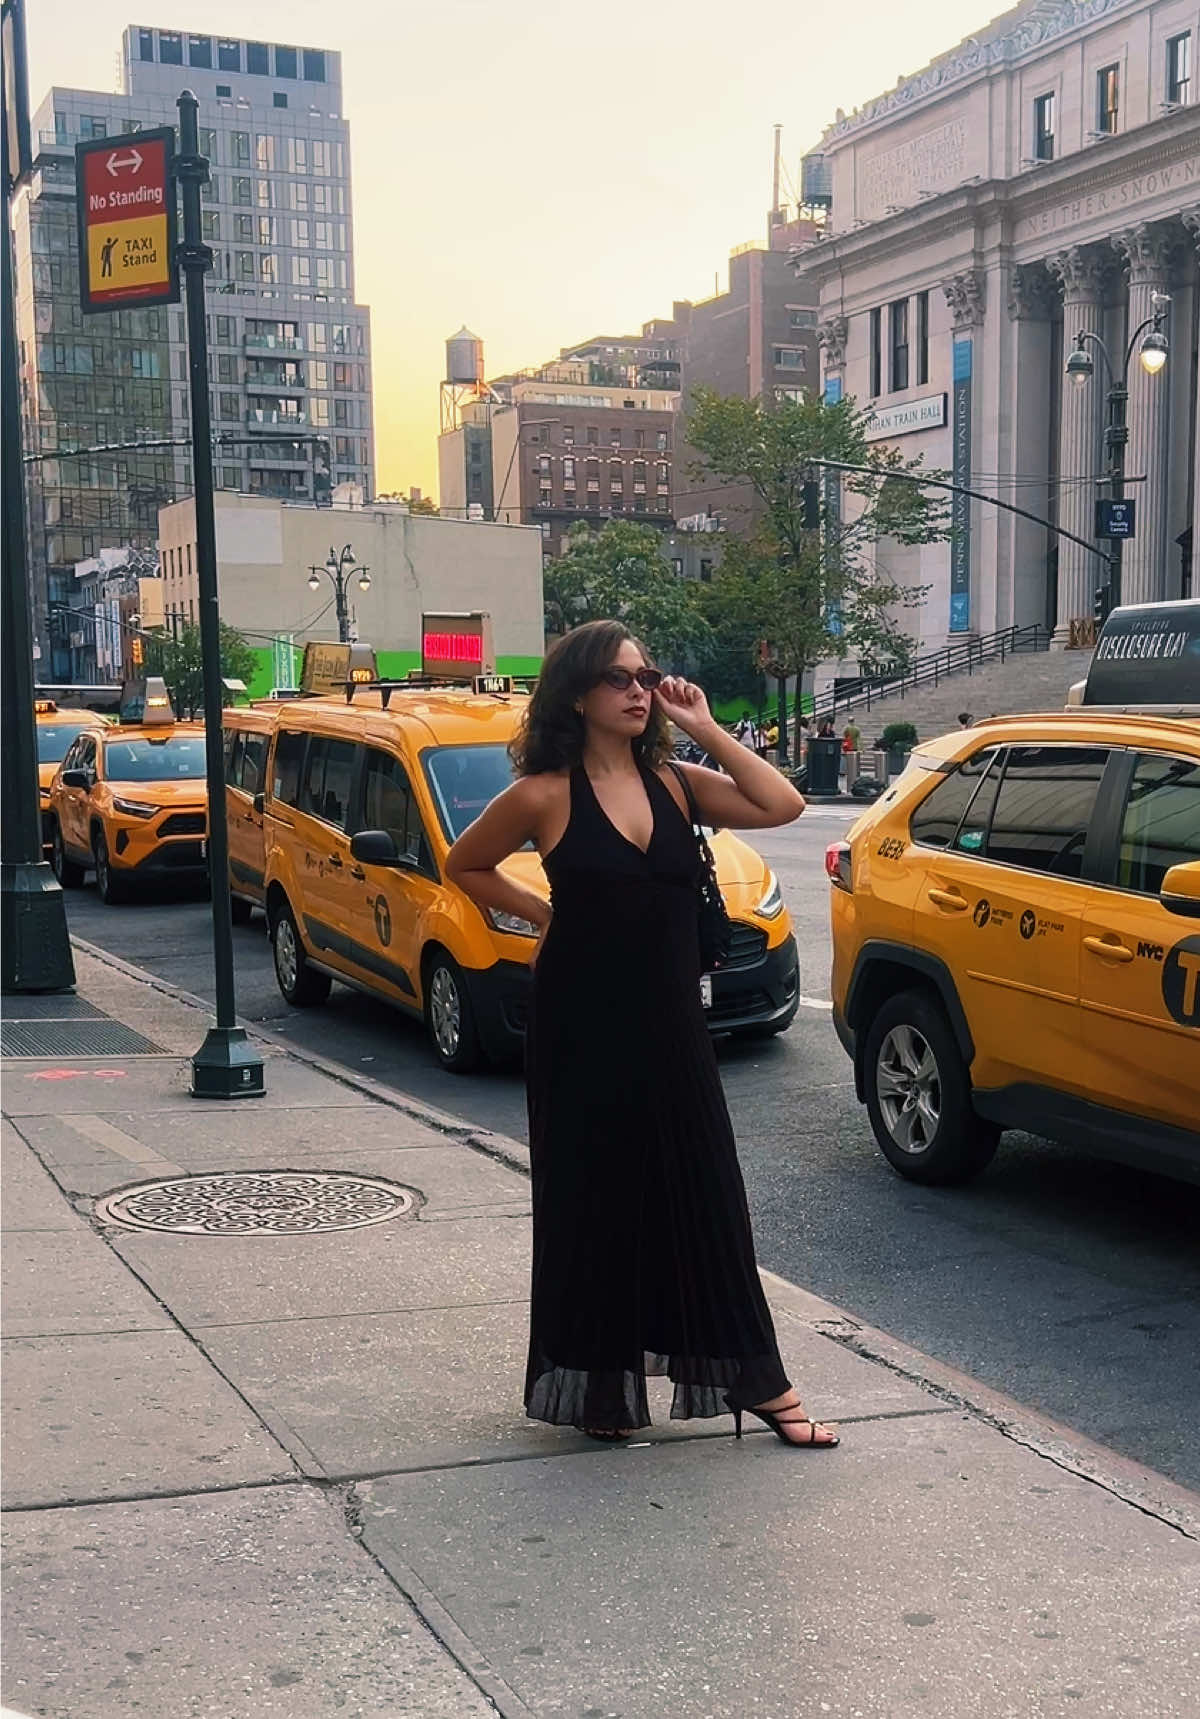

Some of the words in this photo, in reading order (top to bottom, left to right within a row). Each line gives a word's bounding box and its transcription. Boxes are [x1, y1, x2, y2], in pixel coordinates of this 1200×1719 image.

[89, 195, 106, 211] No
[109, 185, 163, 208] Standing
[1027, 194, 1110, 235] NEITHER
[1120, 168, 1175, 201] SNOW
[1184, 159, 1199, 182] N
[125, 237, 153, 252] TAXI
[122, 250, 157, 267] Stand
[894, 407, 918, 427] TRAIN
[921, 403, 941, 420] HALL
[1097, 633, 1165, 660] DISCLOSURE
[1163, 631, 1190, 658] DAY
[1137, 941, 1163, 962] NYC
[1178, 951, 1200, 1016] T
